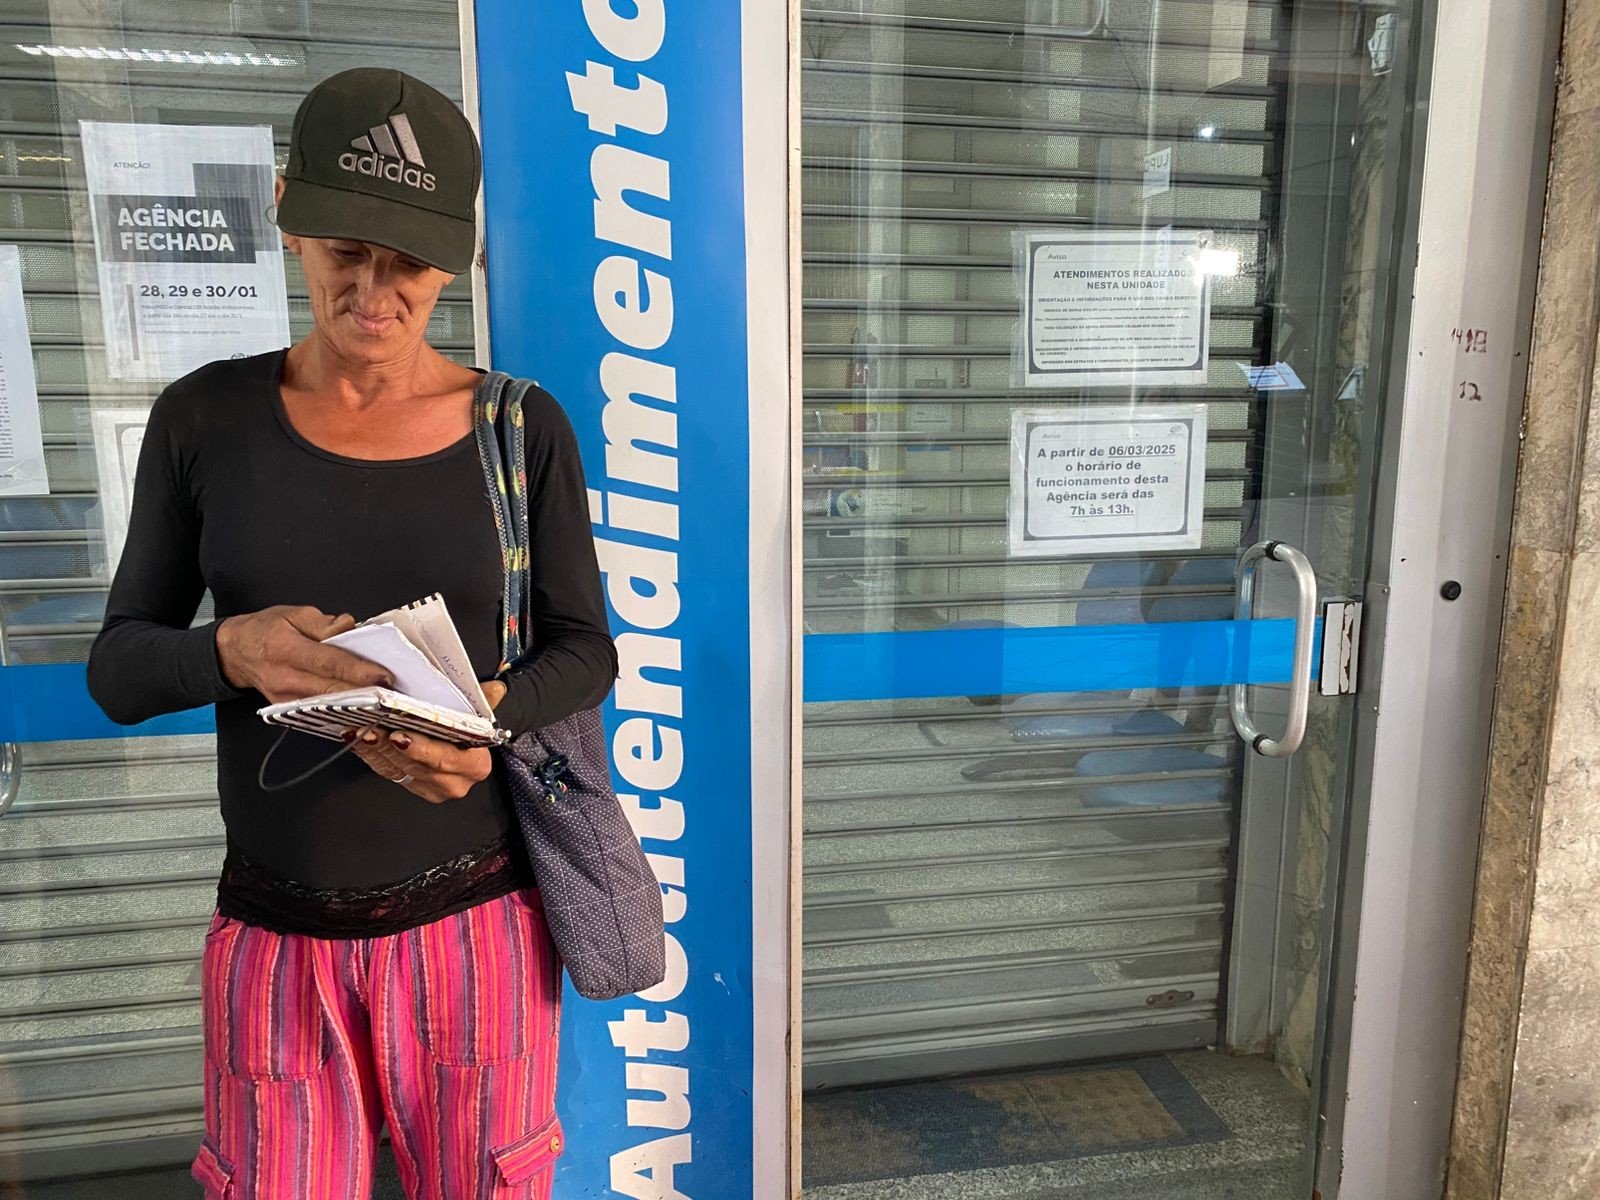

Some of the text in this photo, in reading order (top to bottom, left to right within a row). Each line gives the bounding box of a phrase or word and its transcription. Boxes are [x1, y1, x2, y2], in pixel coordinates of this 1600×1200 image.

[113, 161, 151, 169] ATENÇÃO!
[338, 152, 436, 192] adidas
[118, 203, 228, 228] AGÊNCIA
[120, 232, 235, 252] FECHADA
[1053, 270, 1130, 279] ATENDIMENTOS
[140, 285, 258, 299] 28, 29 e 30/01
[1087, 281, 1166, 290] NESTA UNIDADE
[1037, 444, 1176, 460] A partir de 06/03/2025
[1065, 461, 1141, 472] o horário de
[1036, 474, 1169, 488] funcionamento desta
[1046, 489, 1154, 504] Agência será das
[1070, 503, 1134, 516] 7h às 13h.
